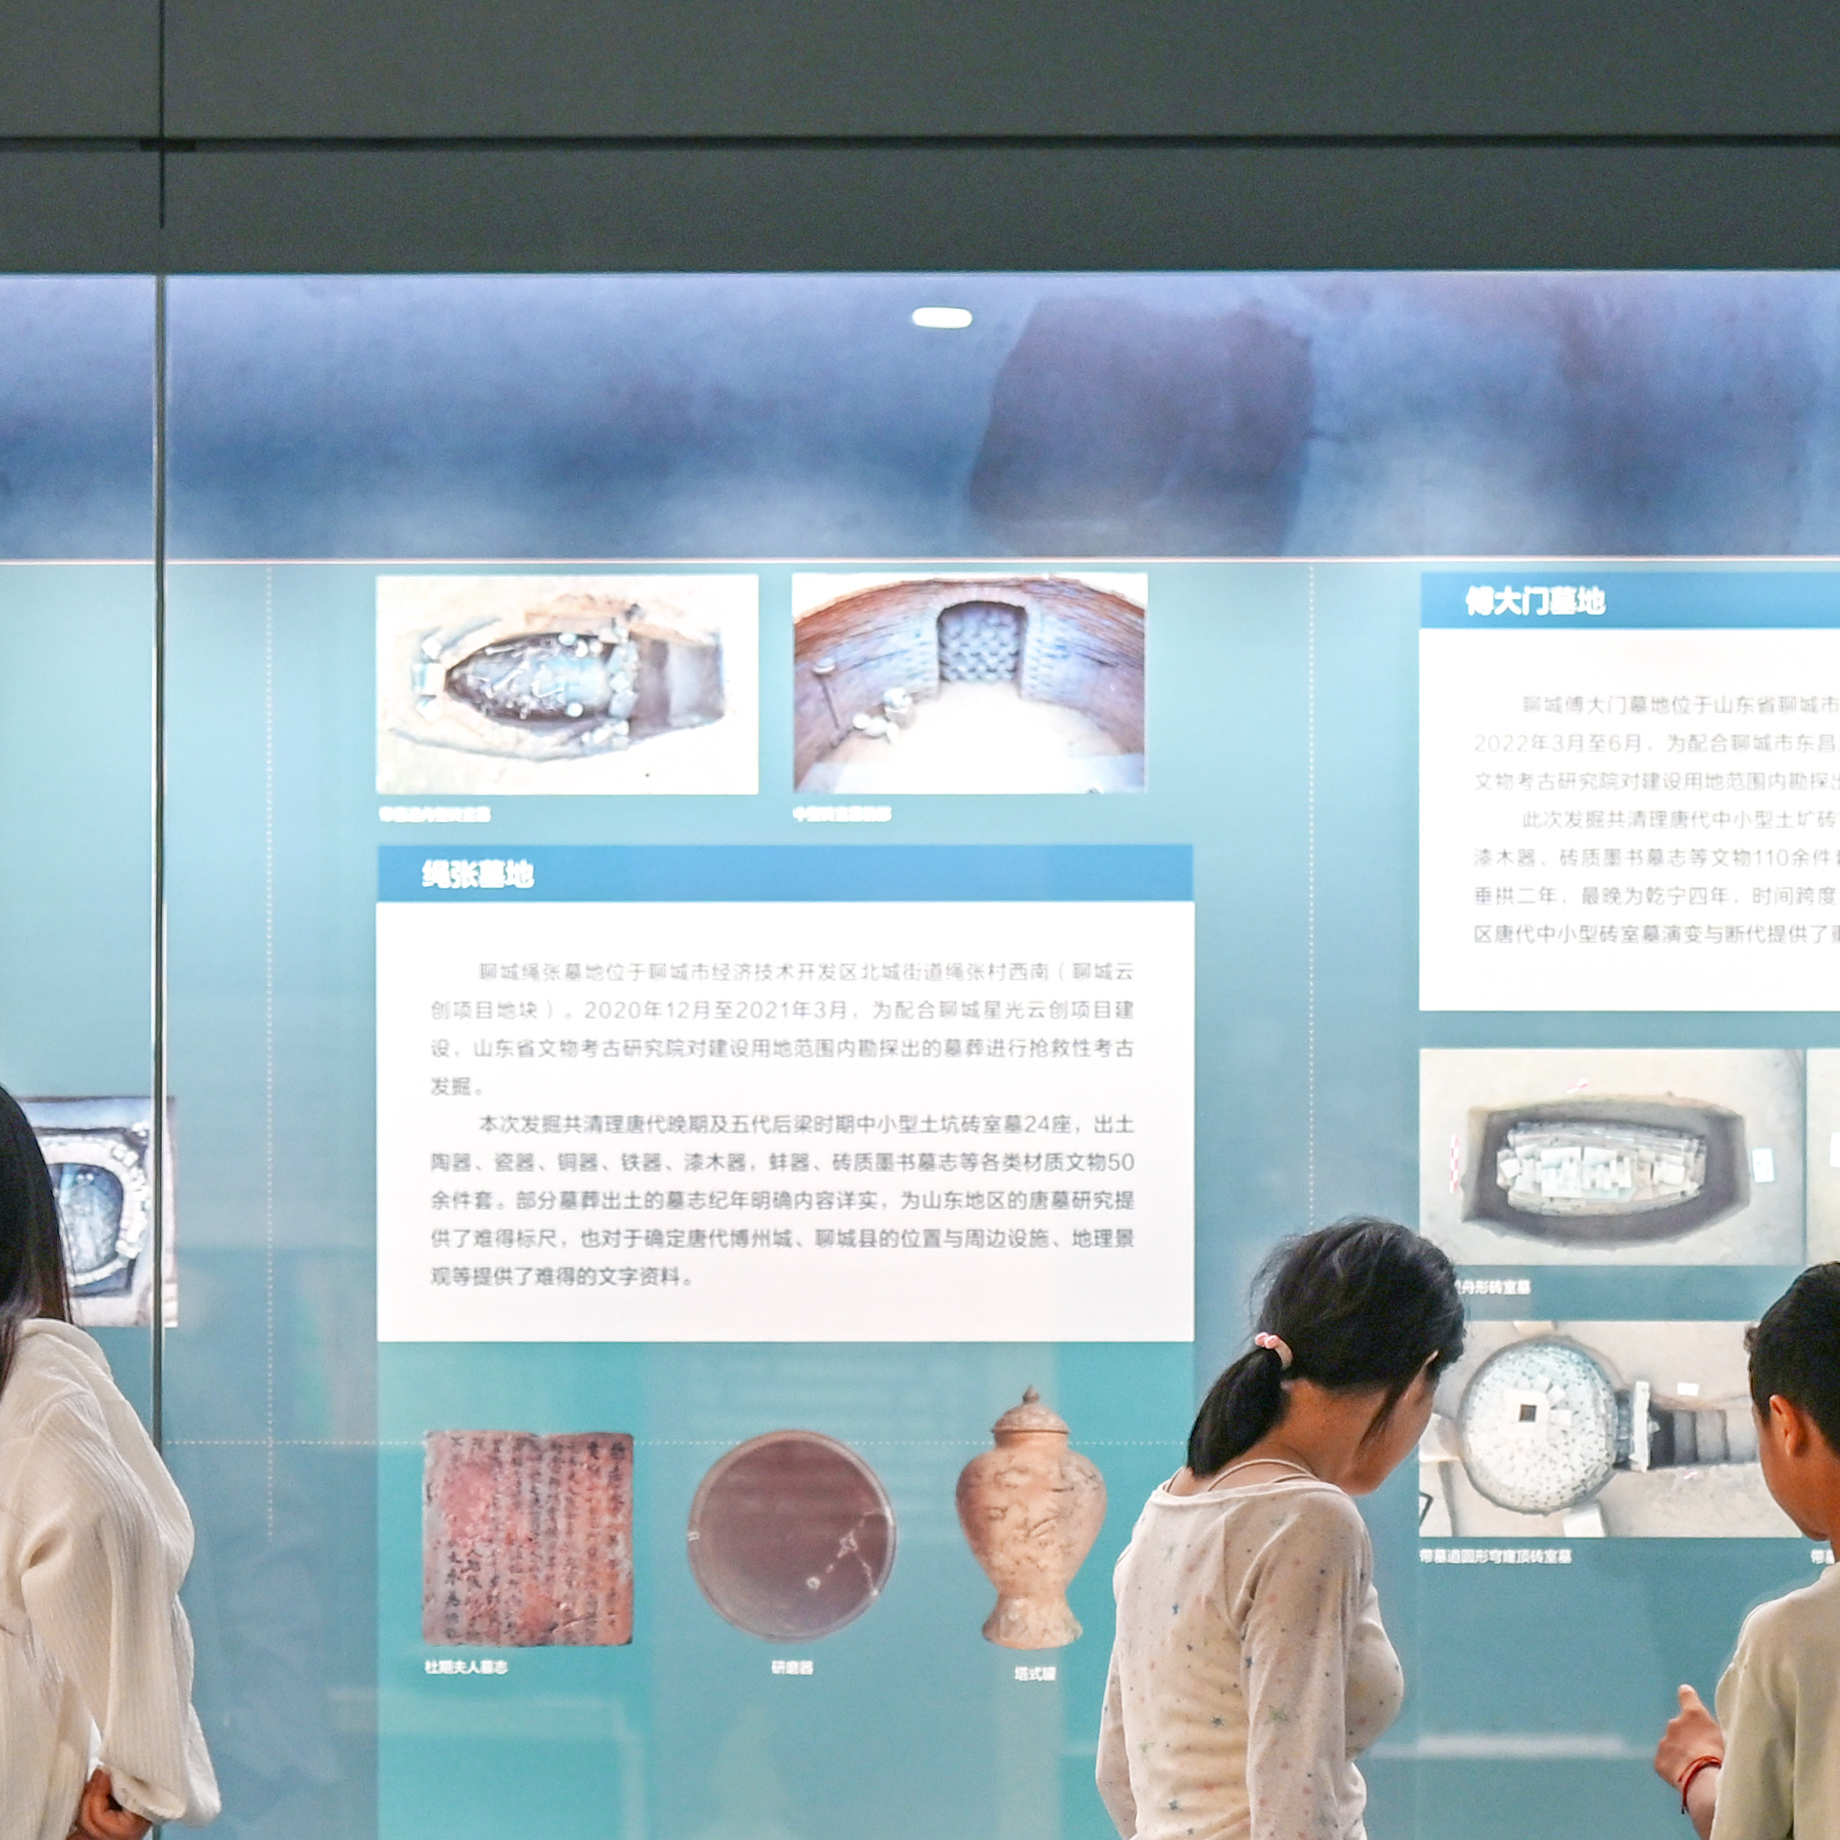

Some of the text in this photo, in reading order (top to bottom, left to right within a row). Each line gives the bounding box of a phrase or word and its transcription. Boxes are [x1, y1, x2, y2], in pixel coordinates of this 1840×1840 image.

[1464, 585, 1607, 616] 傅大门墓地
[421, 859, 535, 889] 绳张墓地
[430, 1076, 481, 1097] 发掘。
